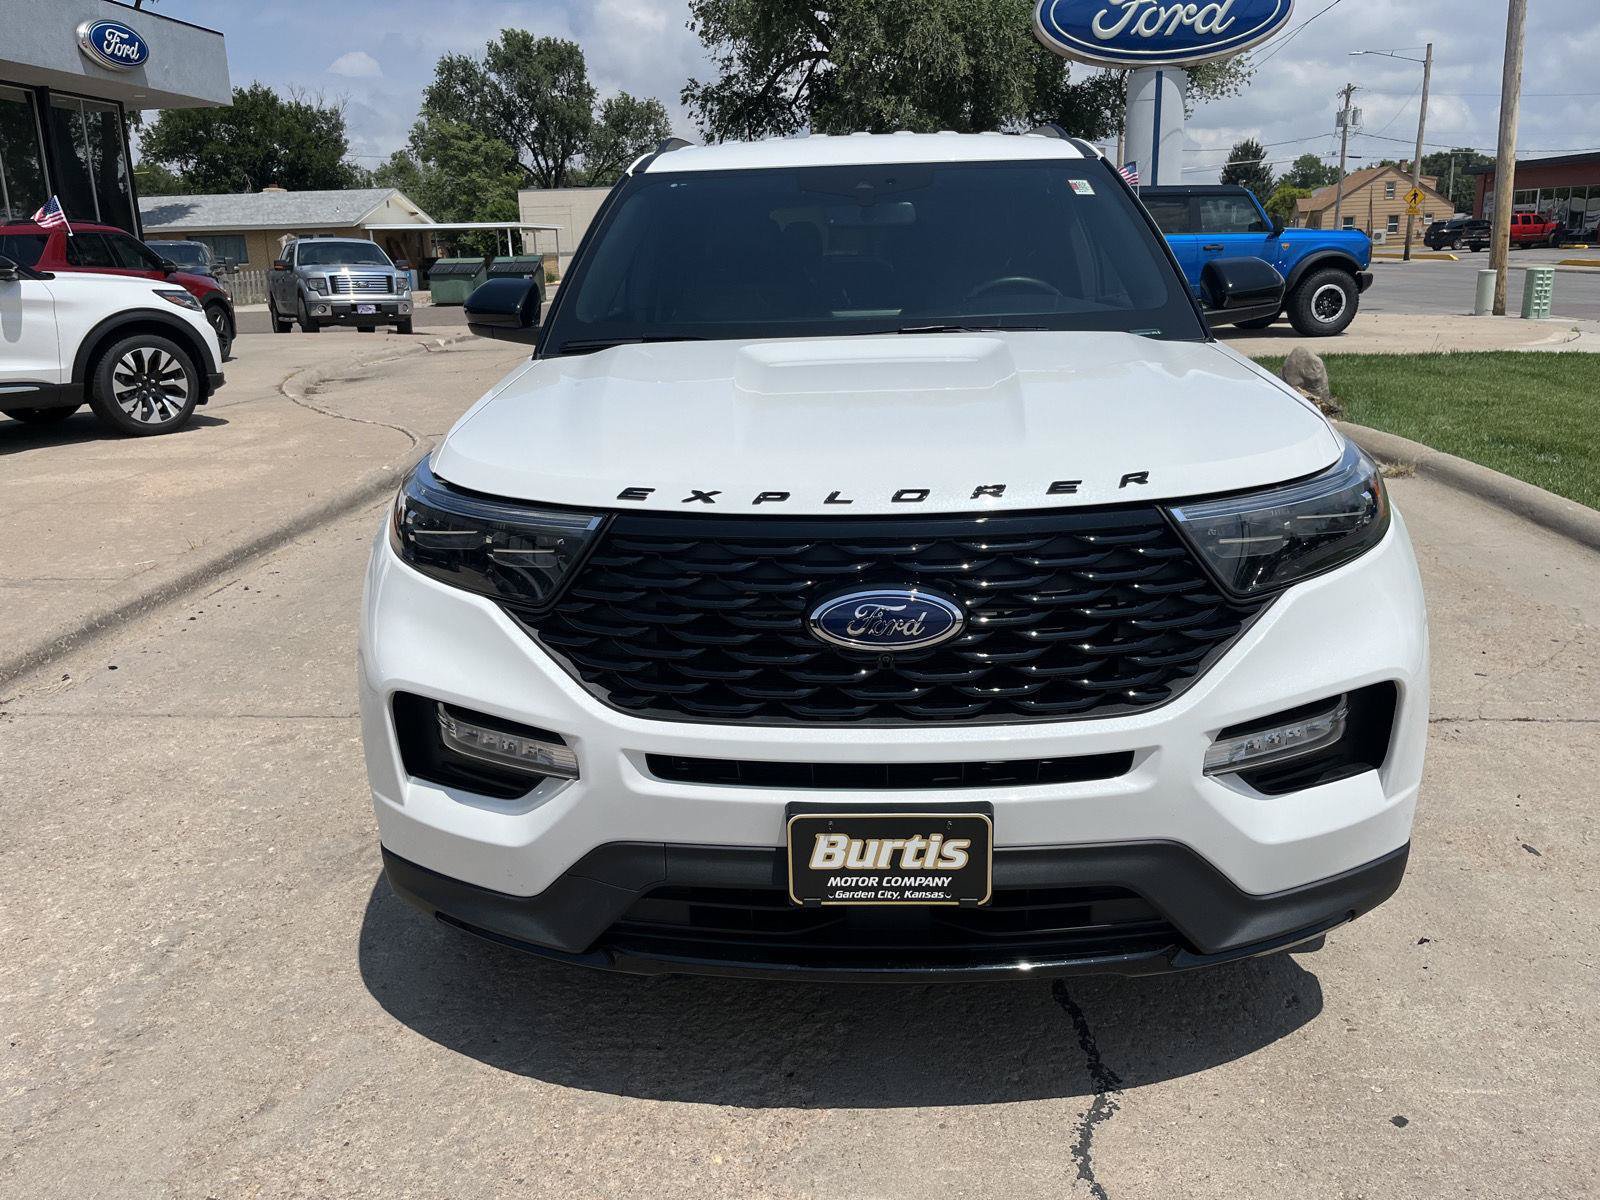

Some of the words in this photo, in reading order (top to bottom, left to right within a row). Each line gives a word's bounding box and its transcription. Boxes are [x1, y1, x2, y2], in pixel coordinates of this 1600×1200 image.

[1091, 0, 1236, 40] Ford
[103, 28, 140, 60] Ford
[616, 470, 1151, 505] EXPLORER
[846, 603, 928, 636] Ford
[808, 833, 971, 870] Burtis
[827, 876, 879, 887] MOTOR
[882, 876, 952, 887] COMPANY
[834, 890, 876, 899] Garden
[878, 890, 901, 900] City,
[903, 890, 945, 899] Kansas
